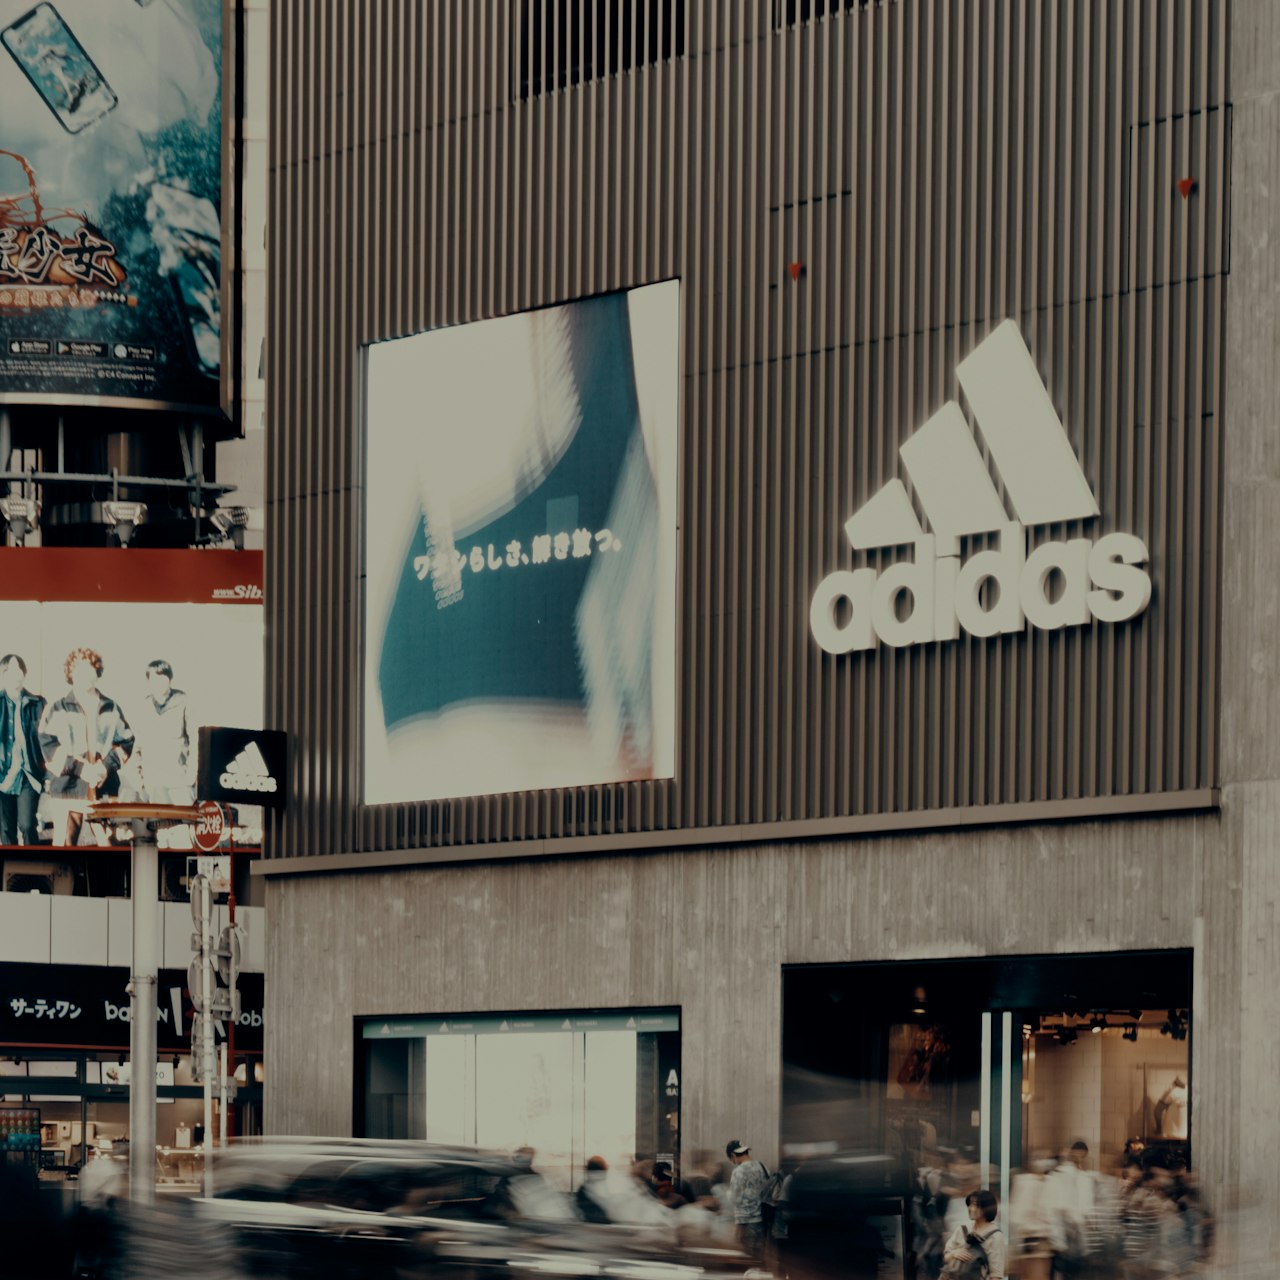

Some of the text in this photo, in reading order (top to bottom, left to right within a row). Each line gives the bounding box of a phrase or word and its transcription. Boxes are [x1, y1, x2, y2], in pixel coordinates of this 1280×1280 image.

[810, 532, 1151, 655] adidas
[10, 997, 82, 1020] サーティワン
